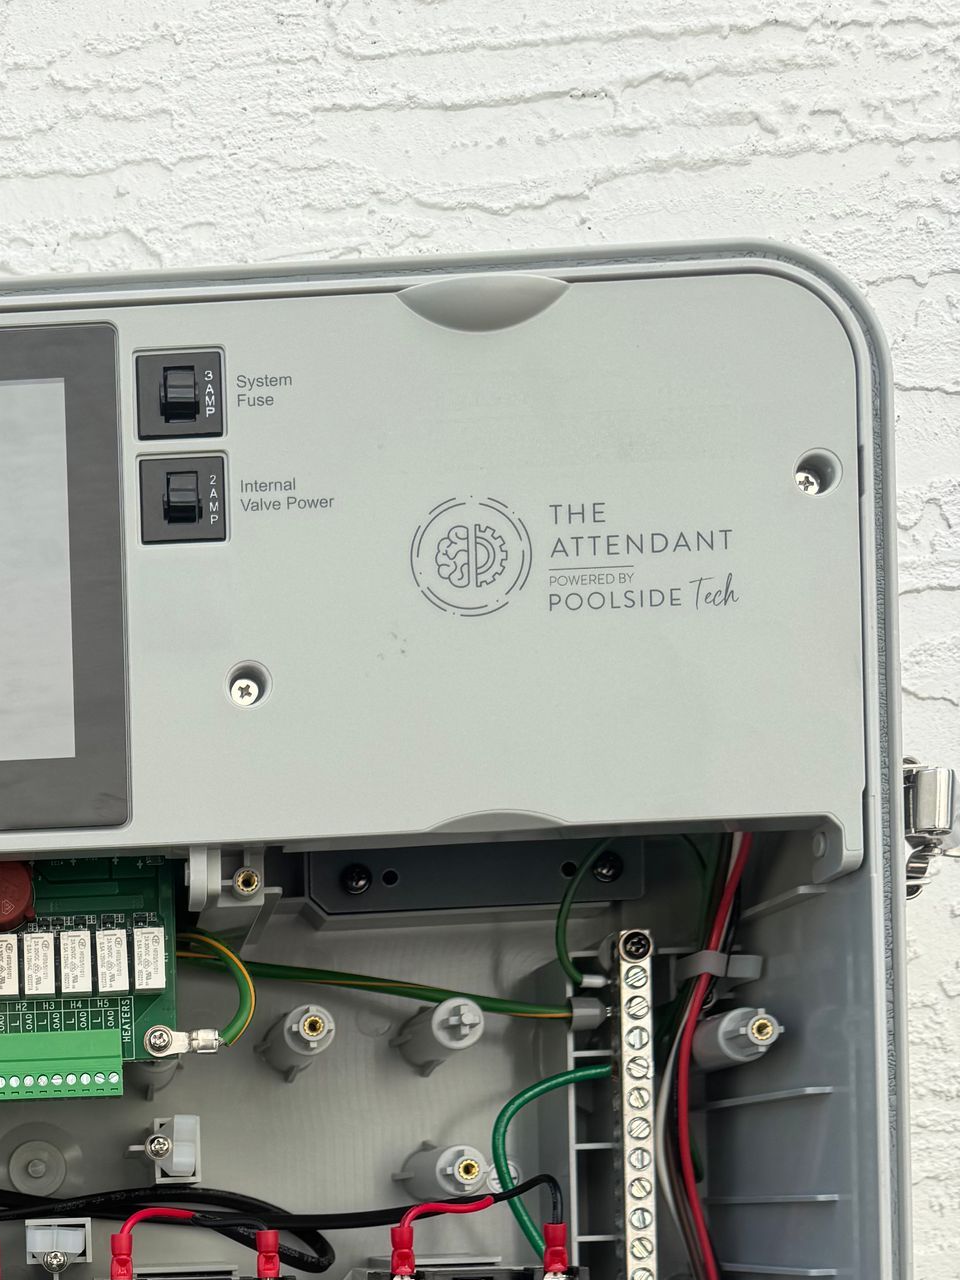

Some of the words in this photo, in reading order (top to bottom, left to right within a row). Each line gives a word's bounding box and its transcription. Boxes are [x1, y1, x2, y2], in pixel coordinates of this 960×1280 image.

[204, 371, 214, 381] 3
[236, 375, 293, 389] System
[205, 384, 216, 418] AMP
[237, 394, 275, 407] Fuse
[209, 474, 217, 485] 2
[240, 478, 296, 493] Internal
[209, 488, 219, 525] AMP
[240, 498, 281, 512] Valve
[286, 496, 335, 509] Power
[548, 502, 606, 525] THE
[550, 529, 733, 558] ATTENDANT
[549, 573, 615, 587] POWERED
[618, 572, 635, 585] BY
[548, 588, 682, 612] POOLSIDE
[688, 572, 740, 611] Tech
[16, 1003, 27, 1011] H2
[43, 1002, 55, 1010] H3
[71, 1001, 82, 1009] H4
[97, 1000, 109, 1008] H5
[122, 999, 131, 1042] HEATERS
